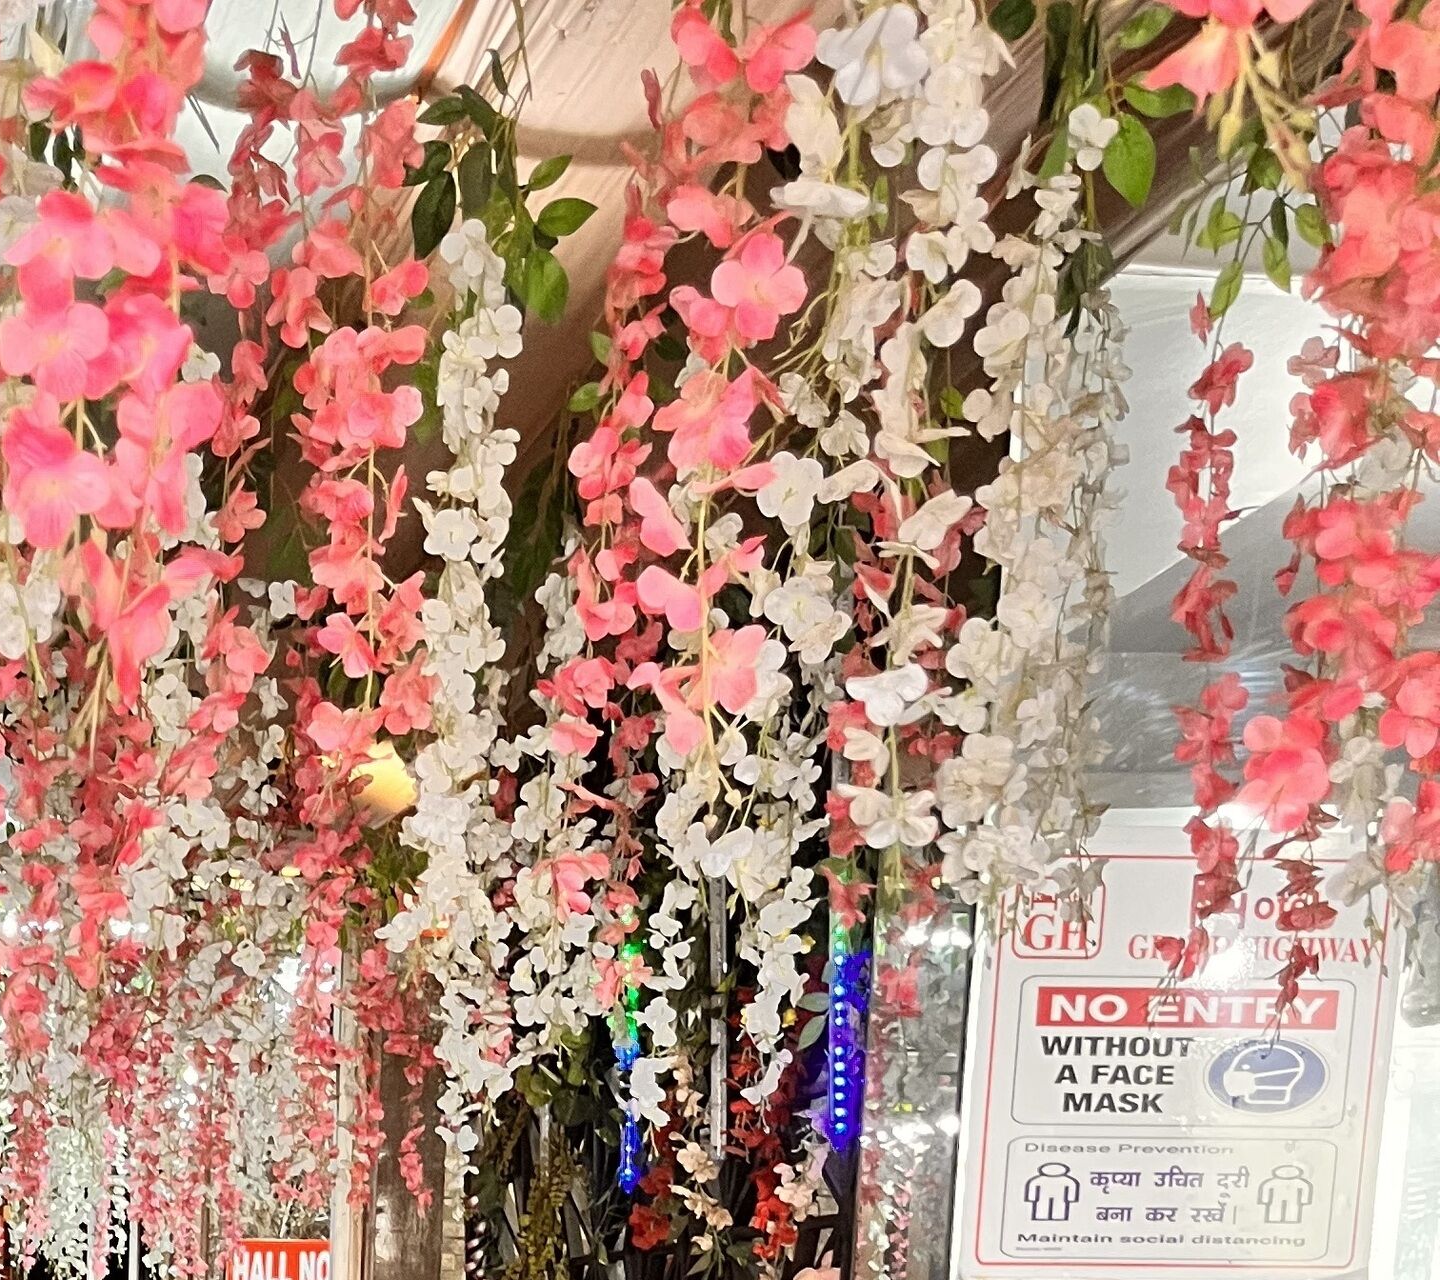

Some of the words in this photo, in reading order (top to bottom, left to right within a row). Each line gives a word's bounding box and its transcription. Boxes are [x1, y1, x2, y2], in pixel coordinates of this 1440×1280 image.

[1049, 993, 1128, 1022] NO
[1041, 1035, 1194, 1057] WITHOUT
[1054, 1065, 1078, 1084] A
[1090, 1065, 1175, 1085] FACE
[1062, 1093, 1164, 1114] MASK
[1025, 1142, 1110, 1154] Disease
[1118, 1143, 1234, 1155] Prevention
[1154, 1165, 1204, 1188] उचित
[1217, 1165, 1250, 1198] दूरी
[1096, 1206, 1132, 1222] बना
[1145, 1206, 1178, 1222] कर
[1017, 1233, 1112, 1244] Maintain
[1120, 1234, 1184, 1245] social
[1192, 1234, 1306, 1247] distancing
